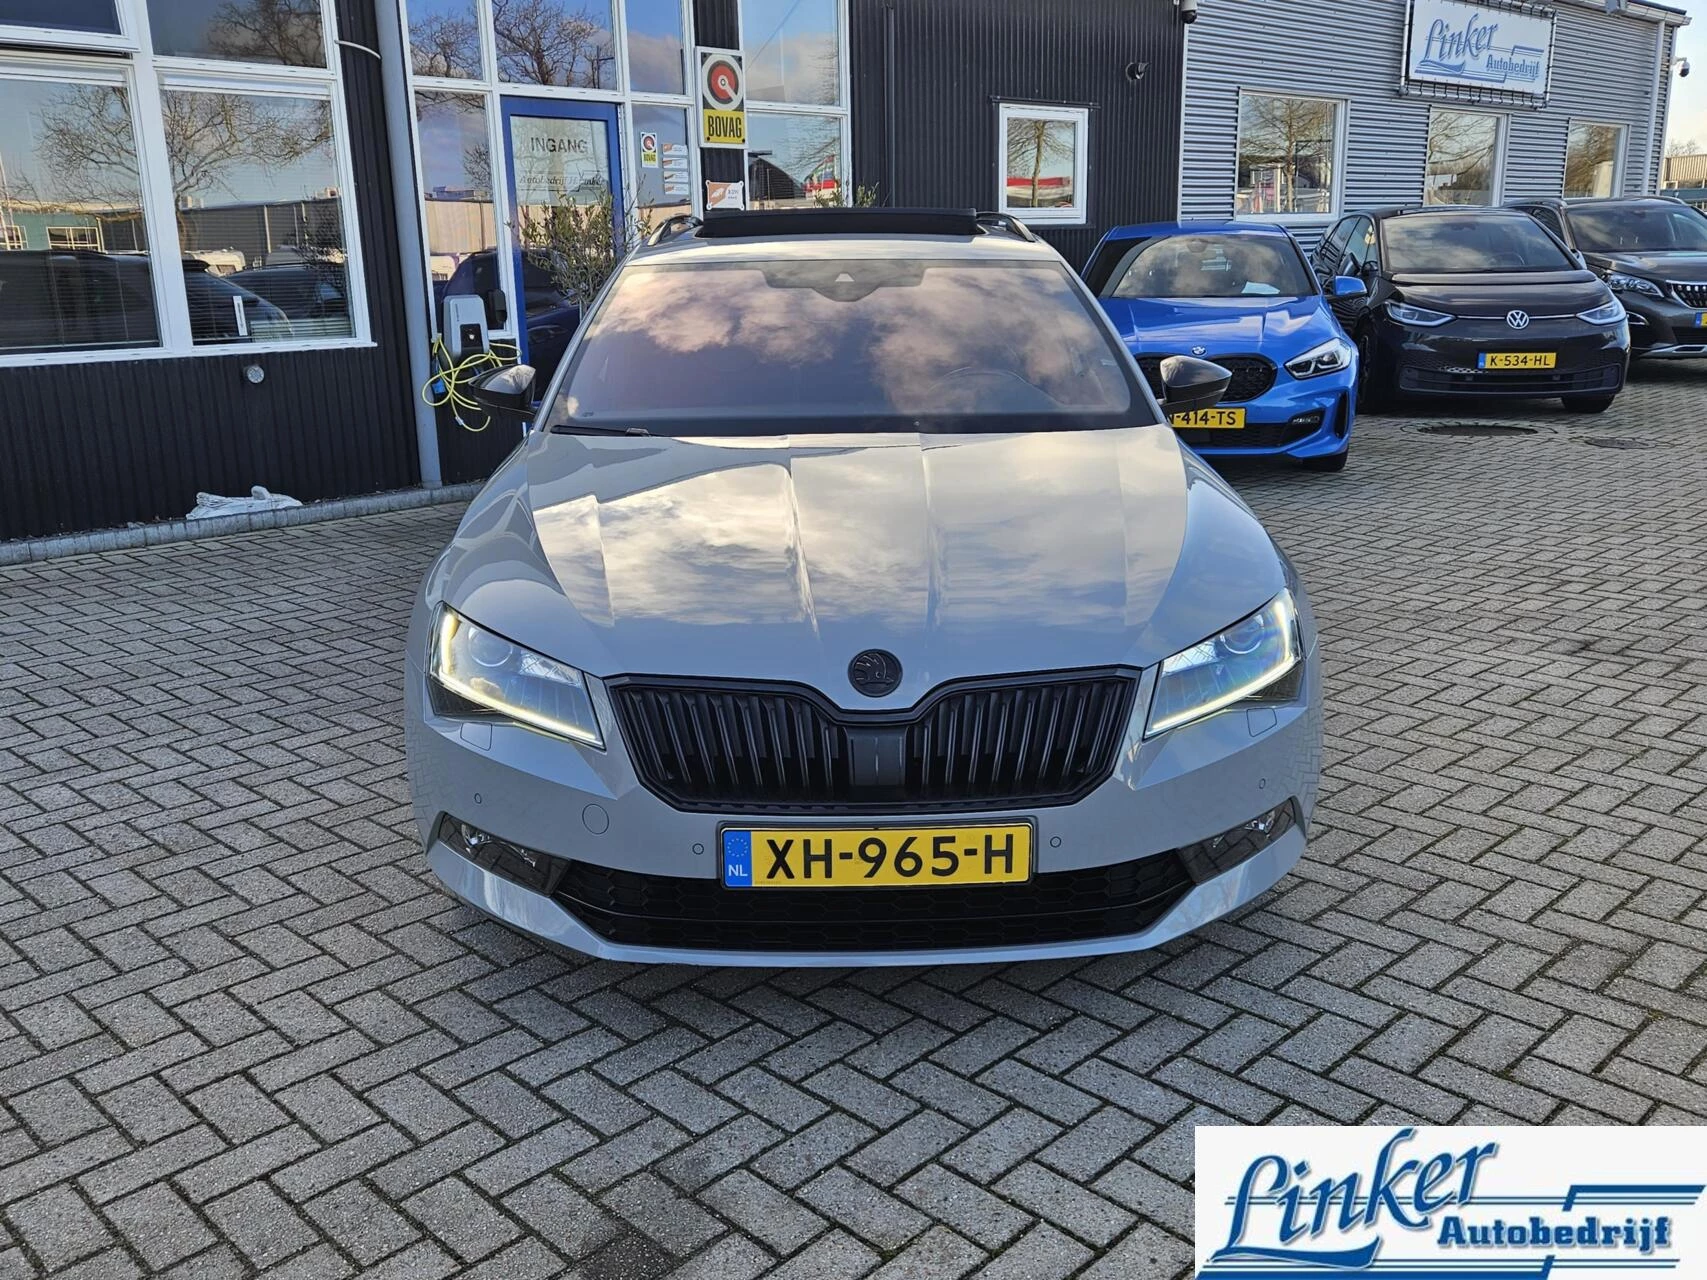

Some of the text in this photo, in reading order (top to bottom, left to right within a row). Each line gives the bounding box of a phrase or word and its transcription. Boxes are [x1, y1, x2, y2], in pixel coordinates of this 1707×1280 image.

[1420, 13, 1498, 73] Linker
[1486, 54, 1540, 77] Autobedrijf
[707, 115, 742, 138] BOVAG
[530, 137, 587, 153] INGANG
[1489, 355, 1550, 367] K-534-HL
[728, 834, 1014, 880] NL XH-965-H
